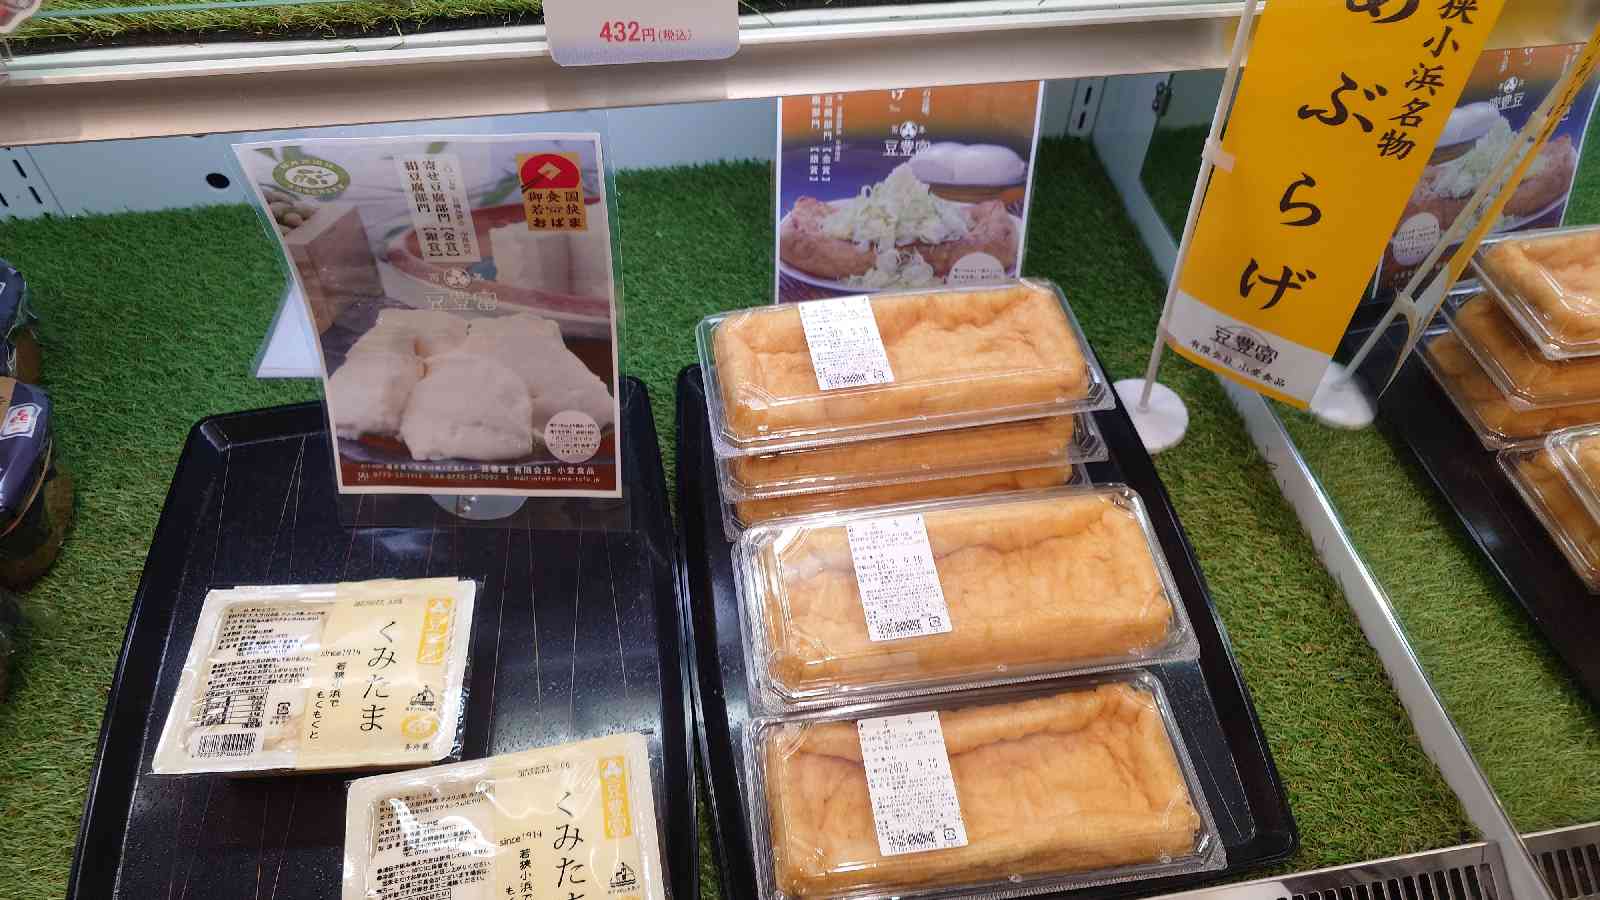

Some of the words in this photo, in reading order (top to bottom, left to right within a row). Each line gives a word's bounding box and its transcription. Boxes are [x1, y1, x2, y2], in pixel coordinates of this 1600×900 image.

[309, 690, 325, 739] もくもくと
[360, 620, 397, 732] くみたま
[554, 791, 586, 900] くみた
